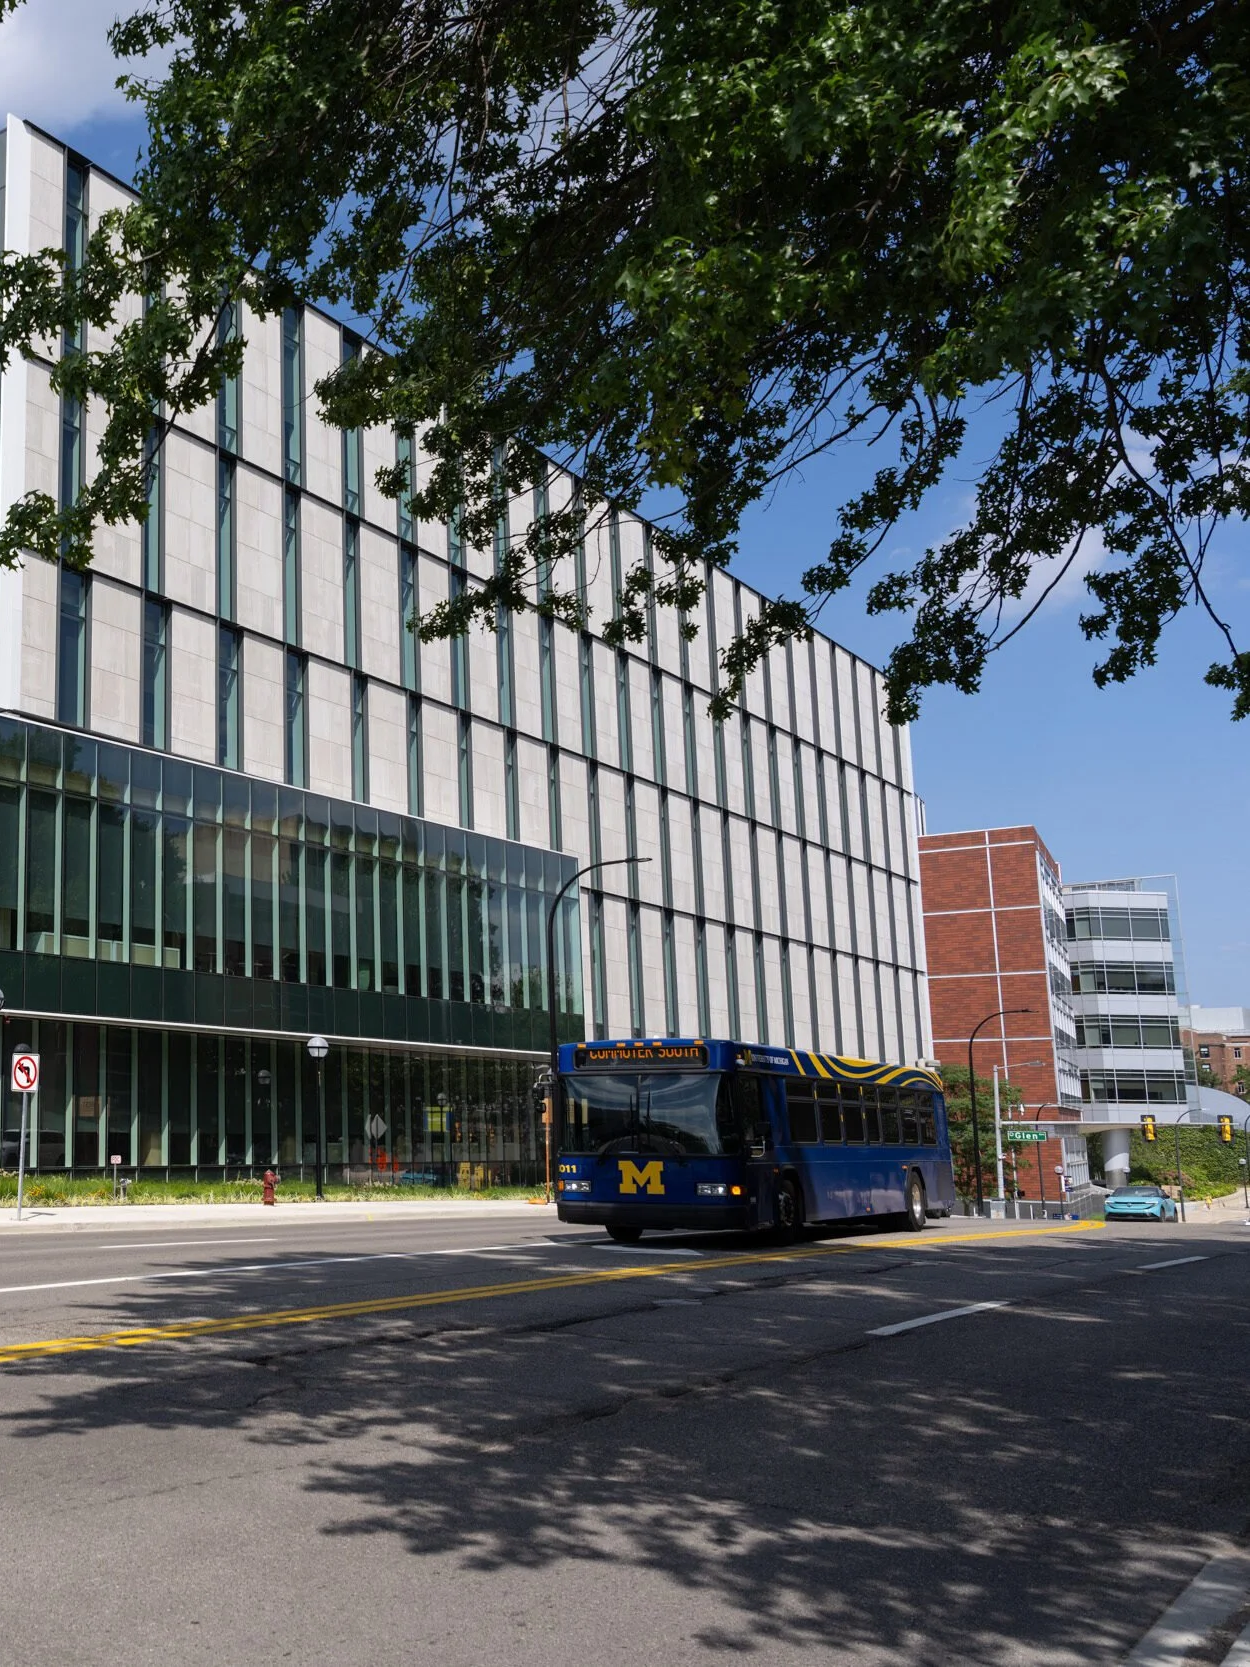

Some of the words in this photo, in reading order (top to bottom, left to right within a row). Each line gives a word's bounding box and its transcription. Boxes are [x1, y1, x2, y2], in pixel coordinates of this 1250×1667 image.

[658, 1048, 699, 1057] SOUTH
[1015, 1132, 1038, 1140] Glen
[618, 1161, 665, 1195] M
